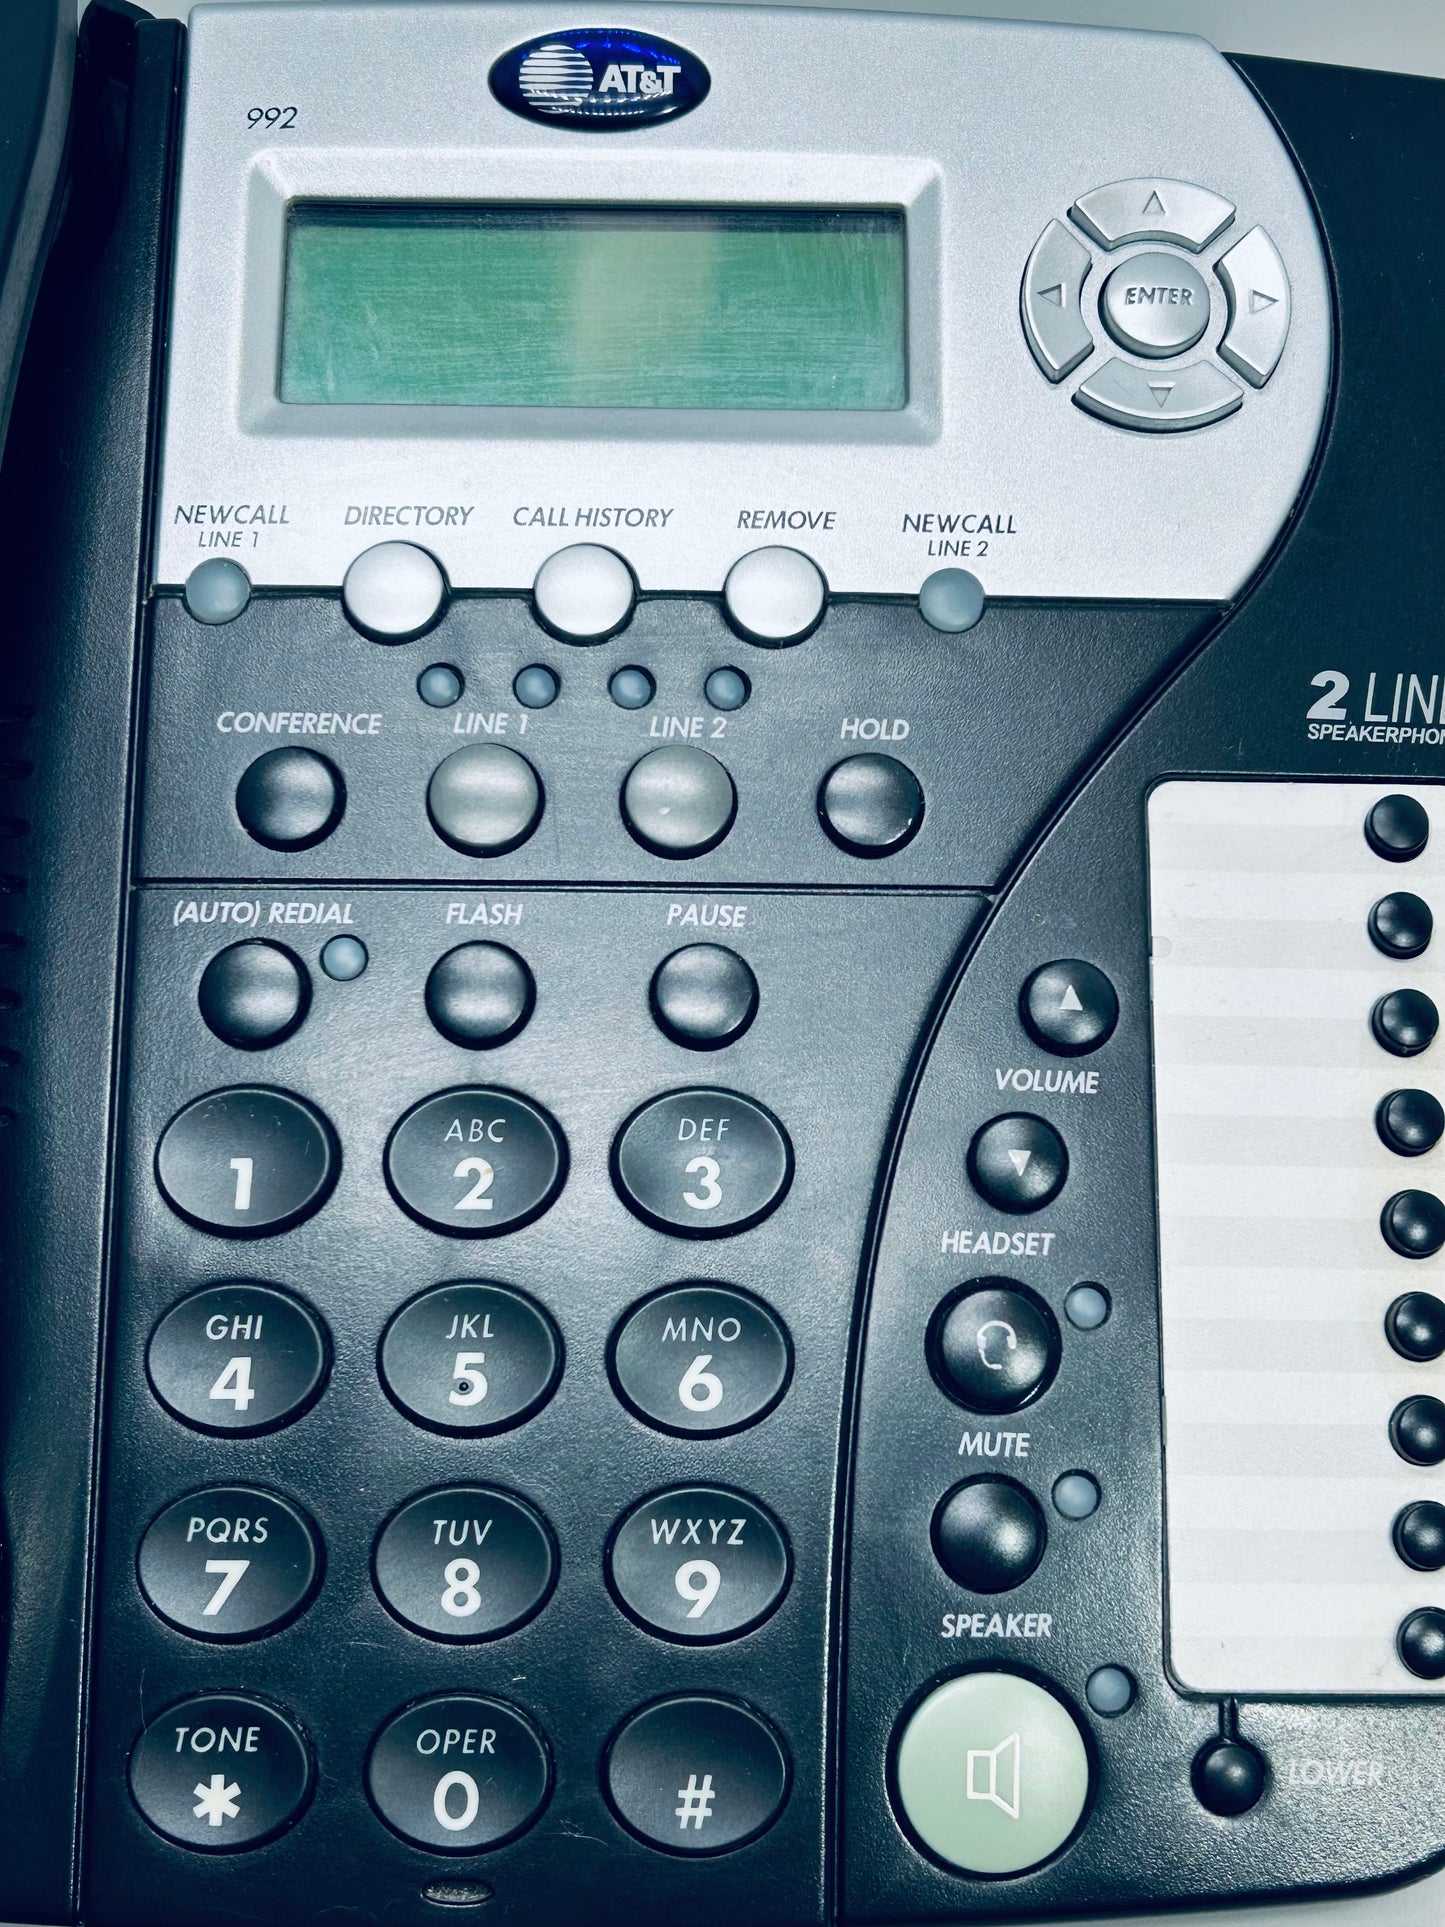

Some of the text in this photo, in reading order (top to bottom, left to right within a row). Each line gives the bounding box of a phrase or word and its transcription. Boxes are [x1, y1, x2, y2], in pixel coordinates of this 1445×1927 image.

[598, 64, 682, 95] AT&T
[246, 106, 298, 130] 992
[1124, 286, 1193, 305] ENTER
[344, 505, 475, 527] DIRECTORY
[513, 507, 674, 529] CALL HISTORY
[737, 510, 837, 531] REMOVE
[198, 531, 259, 548] LINE 1
[927, 540, 989, 558] LINE 2
[1306, 669, 1445, 725] 2 LIN
[216, 711, 384, 735] CONFERENCE
[453, 712, 529, 735] LINE 1
[649, 716, 728, 739] LINE 2
[840, 718, 910, 741] HOLD
[174, 901, 355, 927] (AUTO) REDIAL
[446, 903, 523, 925] FLASH
[666, 904, 748, 928] PAUSE
[995, 1069, 1100, 1095] VOLUME
[444, 1118, 507, 1143] ABC
[677, 1118, 731, 1141] DEF
[230, 1158, 254, 1210] 1
[453, 1157, 495, 1210] 2
[682, 1157, 723, 1210] 3
[940, 1231, 1055, 1257] HEADSET
[205, 1316, 263, 1341] GHI
[445, 1315, 495, 1340] JKL
[661, 1318, 742, 1343] MNO
[208, 1356, 255, 1411] 4
[448, 1352, 488, 1407] 5
[678, 1355, 724, 1413] 6
[957, 1432, 1031, 1457] MUTE
[186, 1517, 269, 1544] PQRS
[432, 1519, 493, 1546] TUV
[650, 1518, 745, 1546] WXYZ
[202, 1560, 250, 1616] 7
[440, 1558, 483, 1618] 8
[673, 1559, 721, 1619] 9
[940, 1612, 1053, 1637] SPEAKER
[174, 1726, 260, 1753] TONE
[416, 1729, 497, 1755] OPER
[1289, 1758, 1384, 1786] LOWER
[433, 1770, 480, 1832] 0
